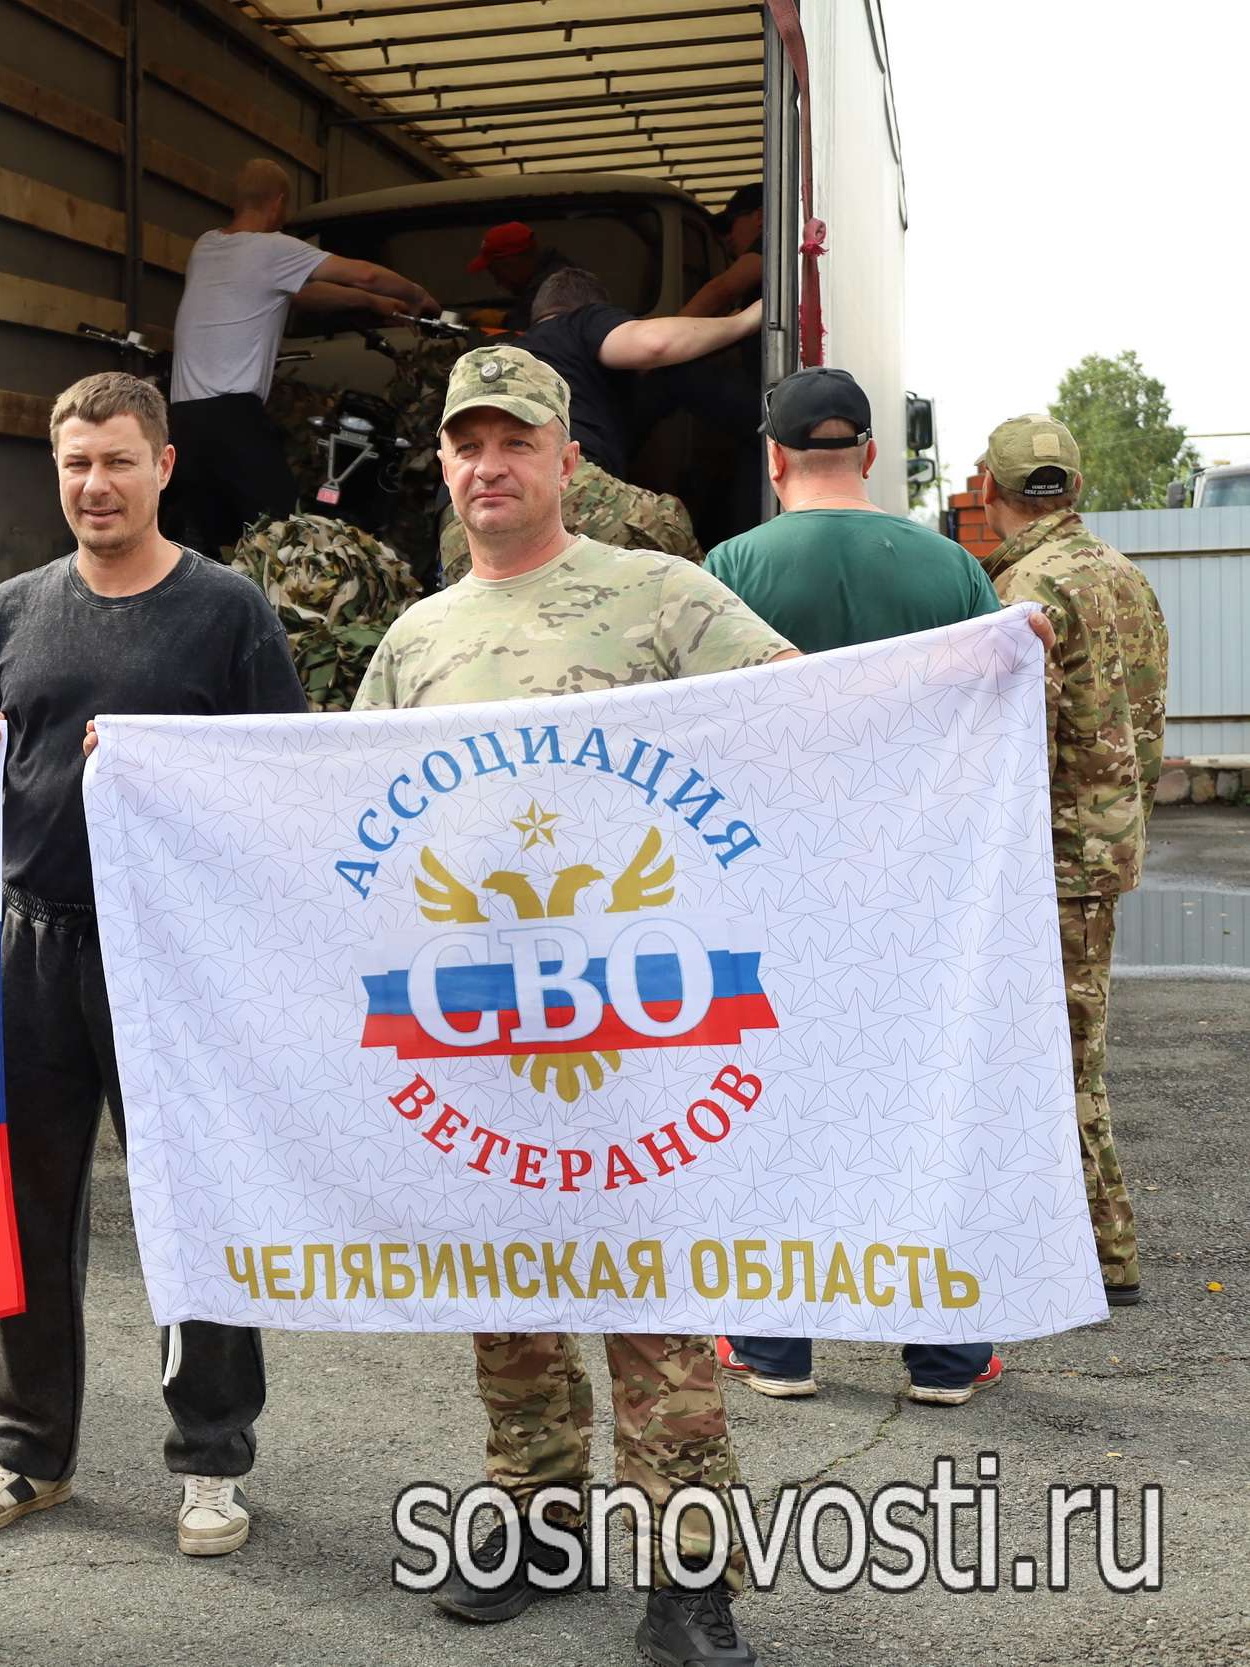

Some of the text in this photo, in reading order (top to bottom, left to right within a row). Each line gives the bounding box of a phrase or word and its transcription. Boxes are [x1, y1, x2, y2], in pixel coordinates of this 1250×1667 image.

[333, 724, 762, 900] АССОЦИАЦИЯ
[406, 916, 714, 1047] СВО
[388, 1062, 763, 1193] ВЕТЕРАНОВ
[224, 1239, 981, 1309] ЧЕЛЯБИНСКАЯ ОБЛАСТЬ
